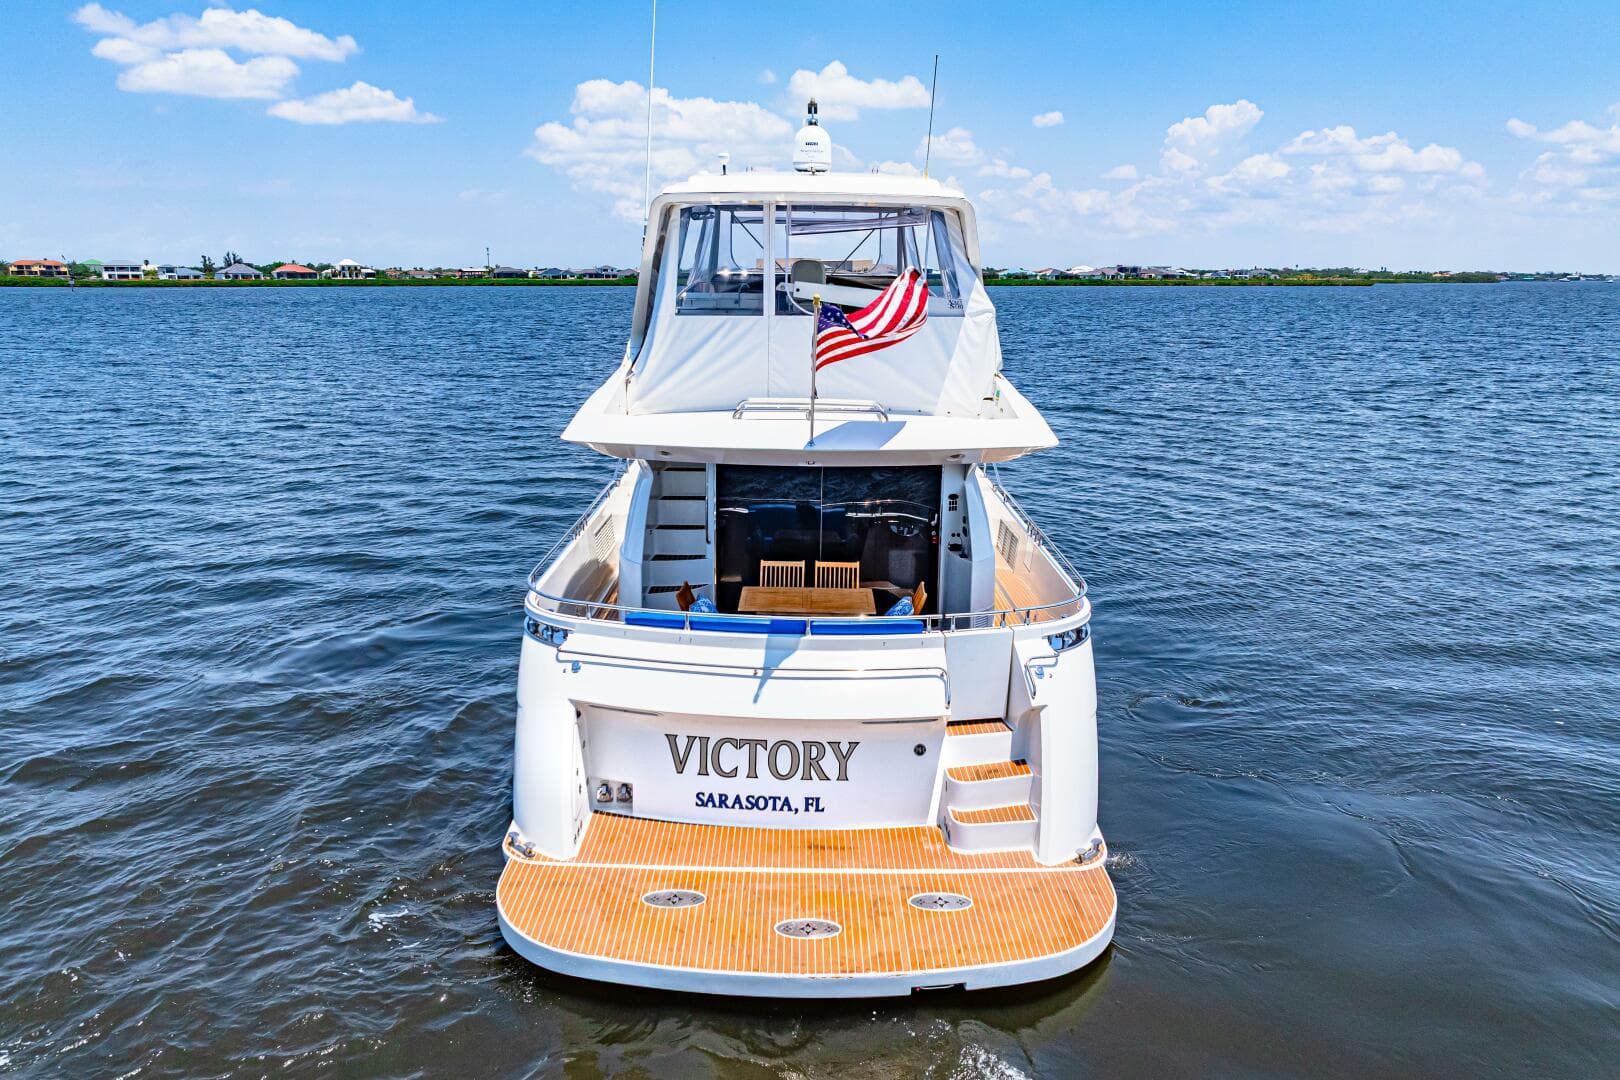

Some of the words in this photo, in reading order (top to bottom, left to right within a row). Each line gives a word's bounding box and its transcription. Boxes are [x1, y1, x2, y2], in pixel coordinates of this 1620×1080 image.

[664, 733, 860, 782] VICTORY
[695, 791, 799, 815] SARASOTA,
[803, 796, 825, 813] FL
